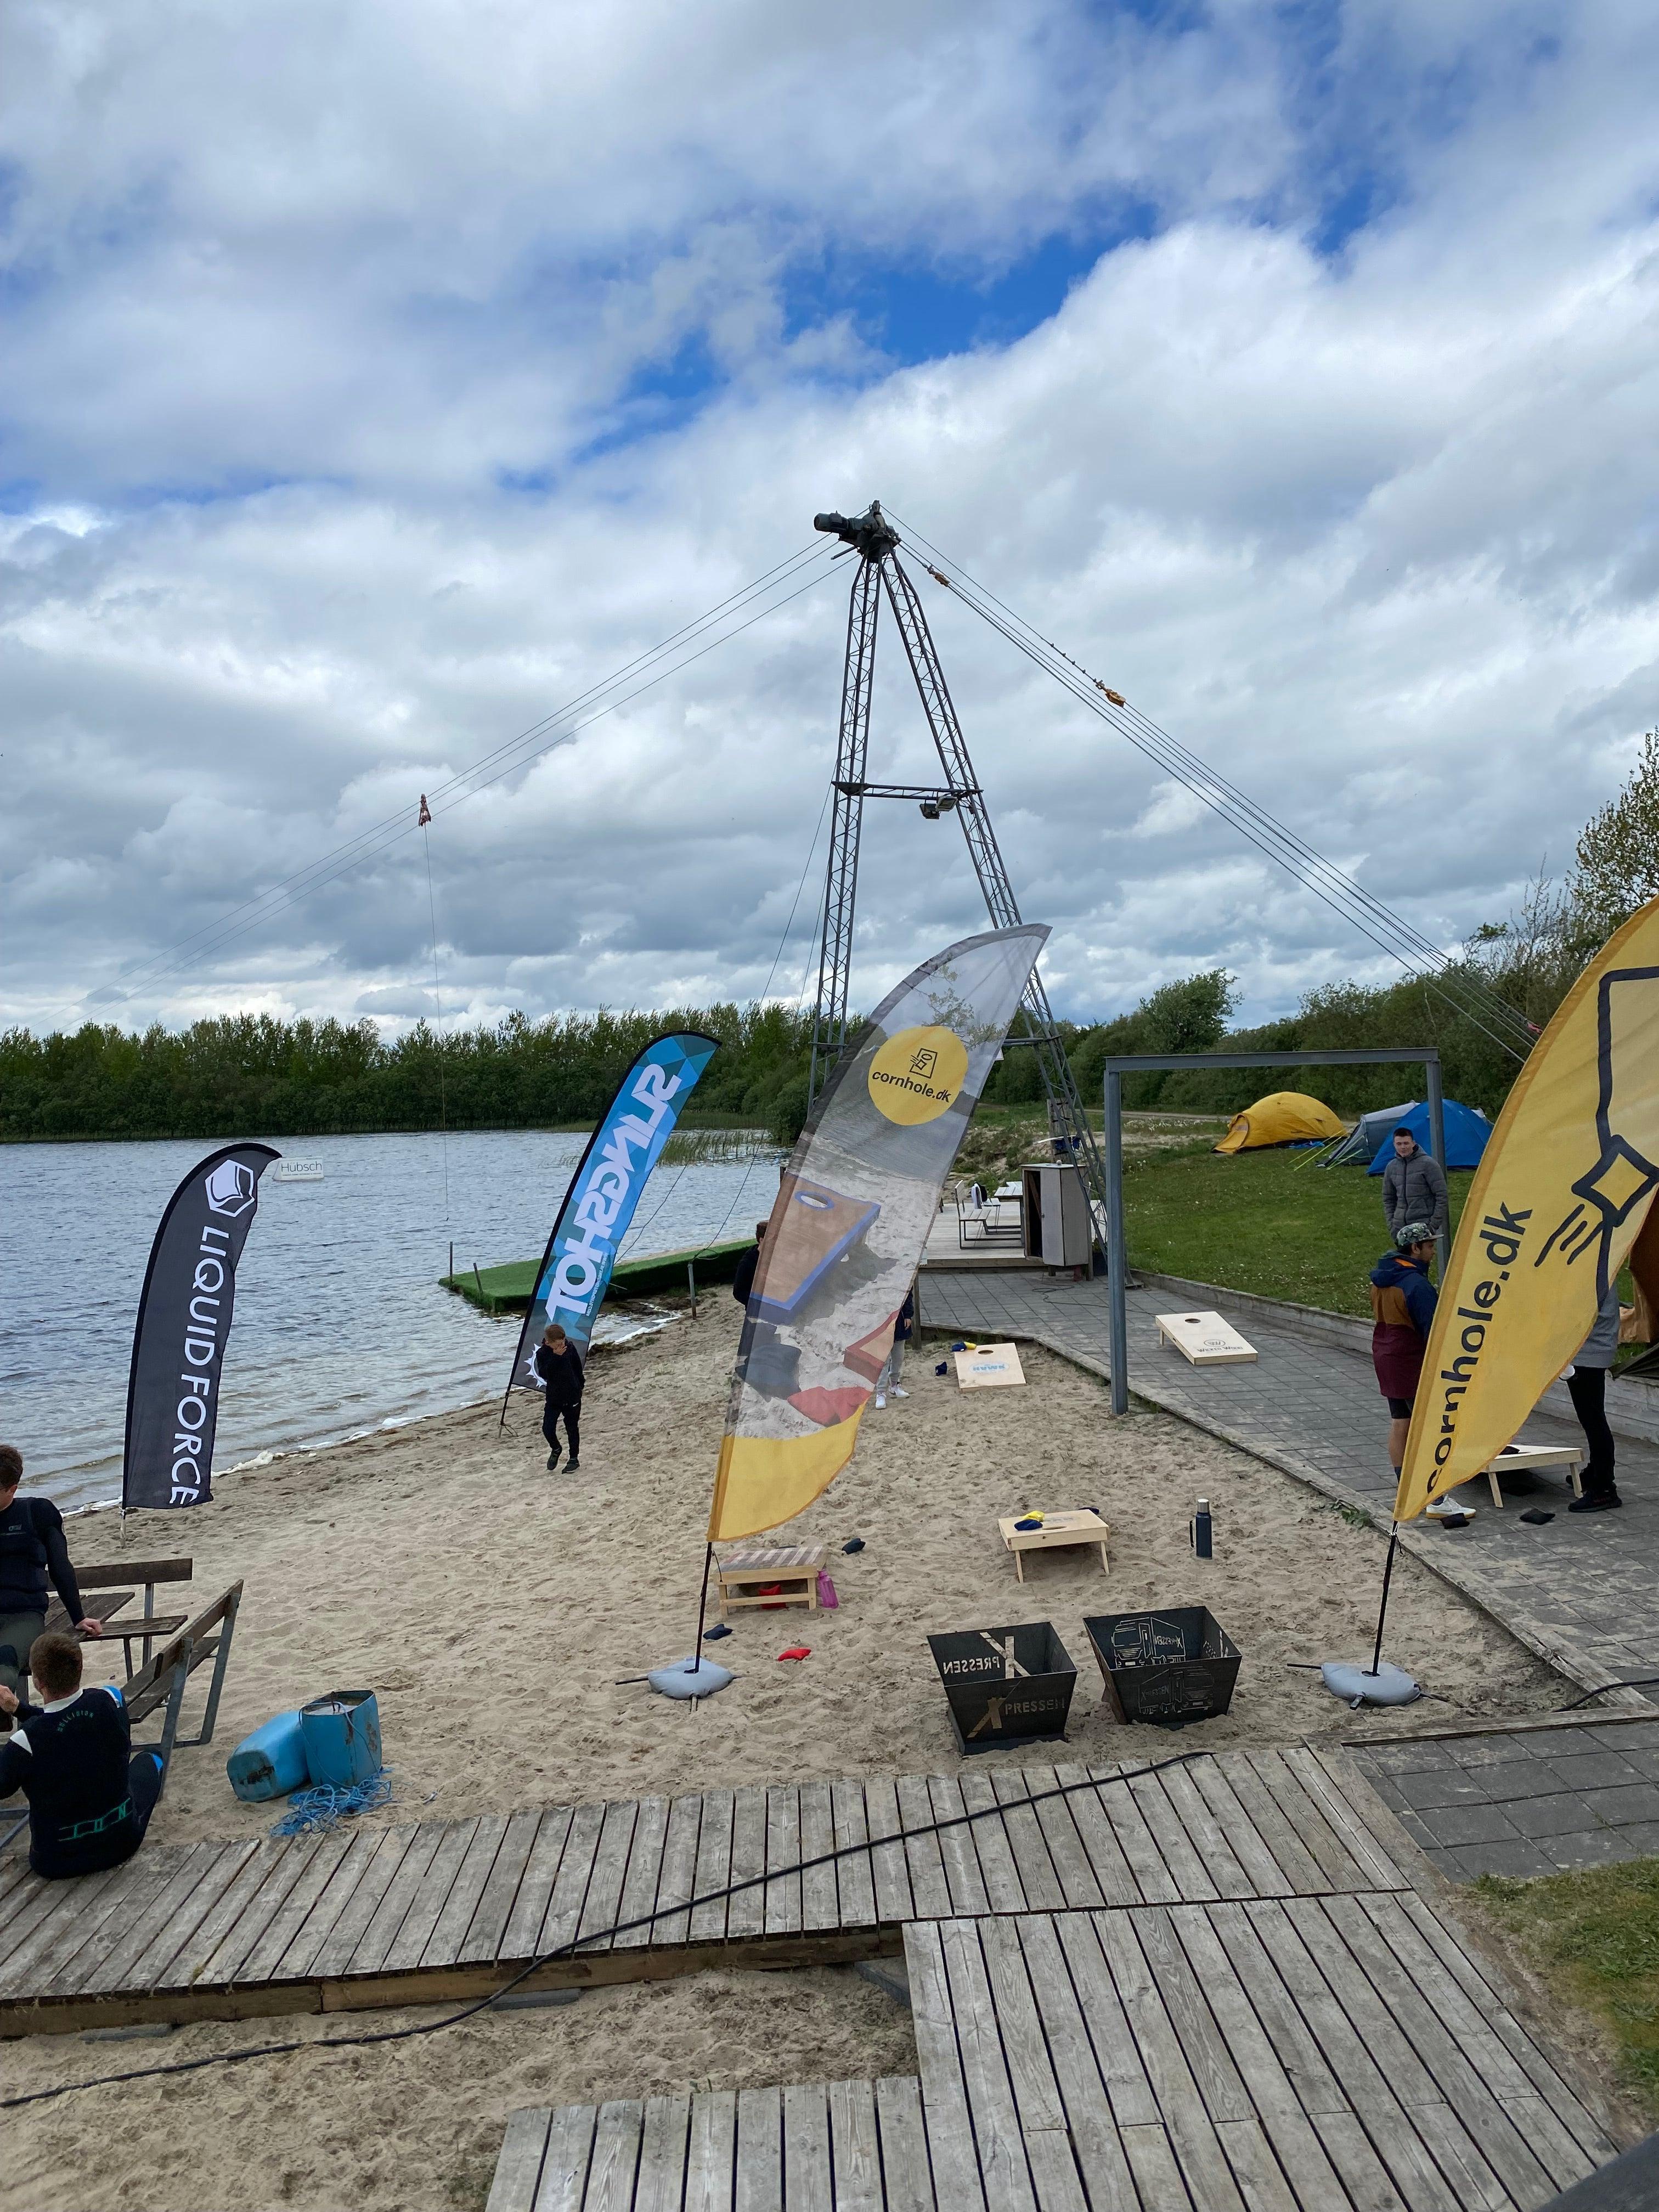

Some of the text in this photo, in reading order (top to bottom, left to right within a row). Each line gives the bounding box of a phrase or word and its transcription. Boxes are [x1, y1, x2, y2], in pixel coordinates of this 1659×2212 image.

[872, 1071, 952, 1103] cornhole.dk
[281, 1160, 322, 1172] Hübsch
[169, 1226, 229, 1505] LIQUID FORCE
[1426, 1201, 1533, 1494] cornhole.dk
